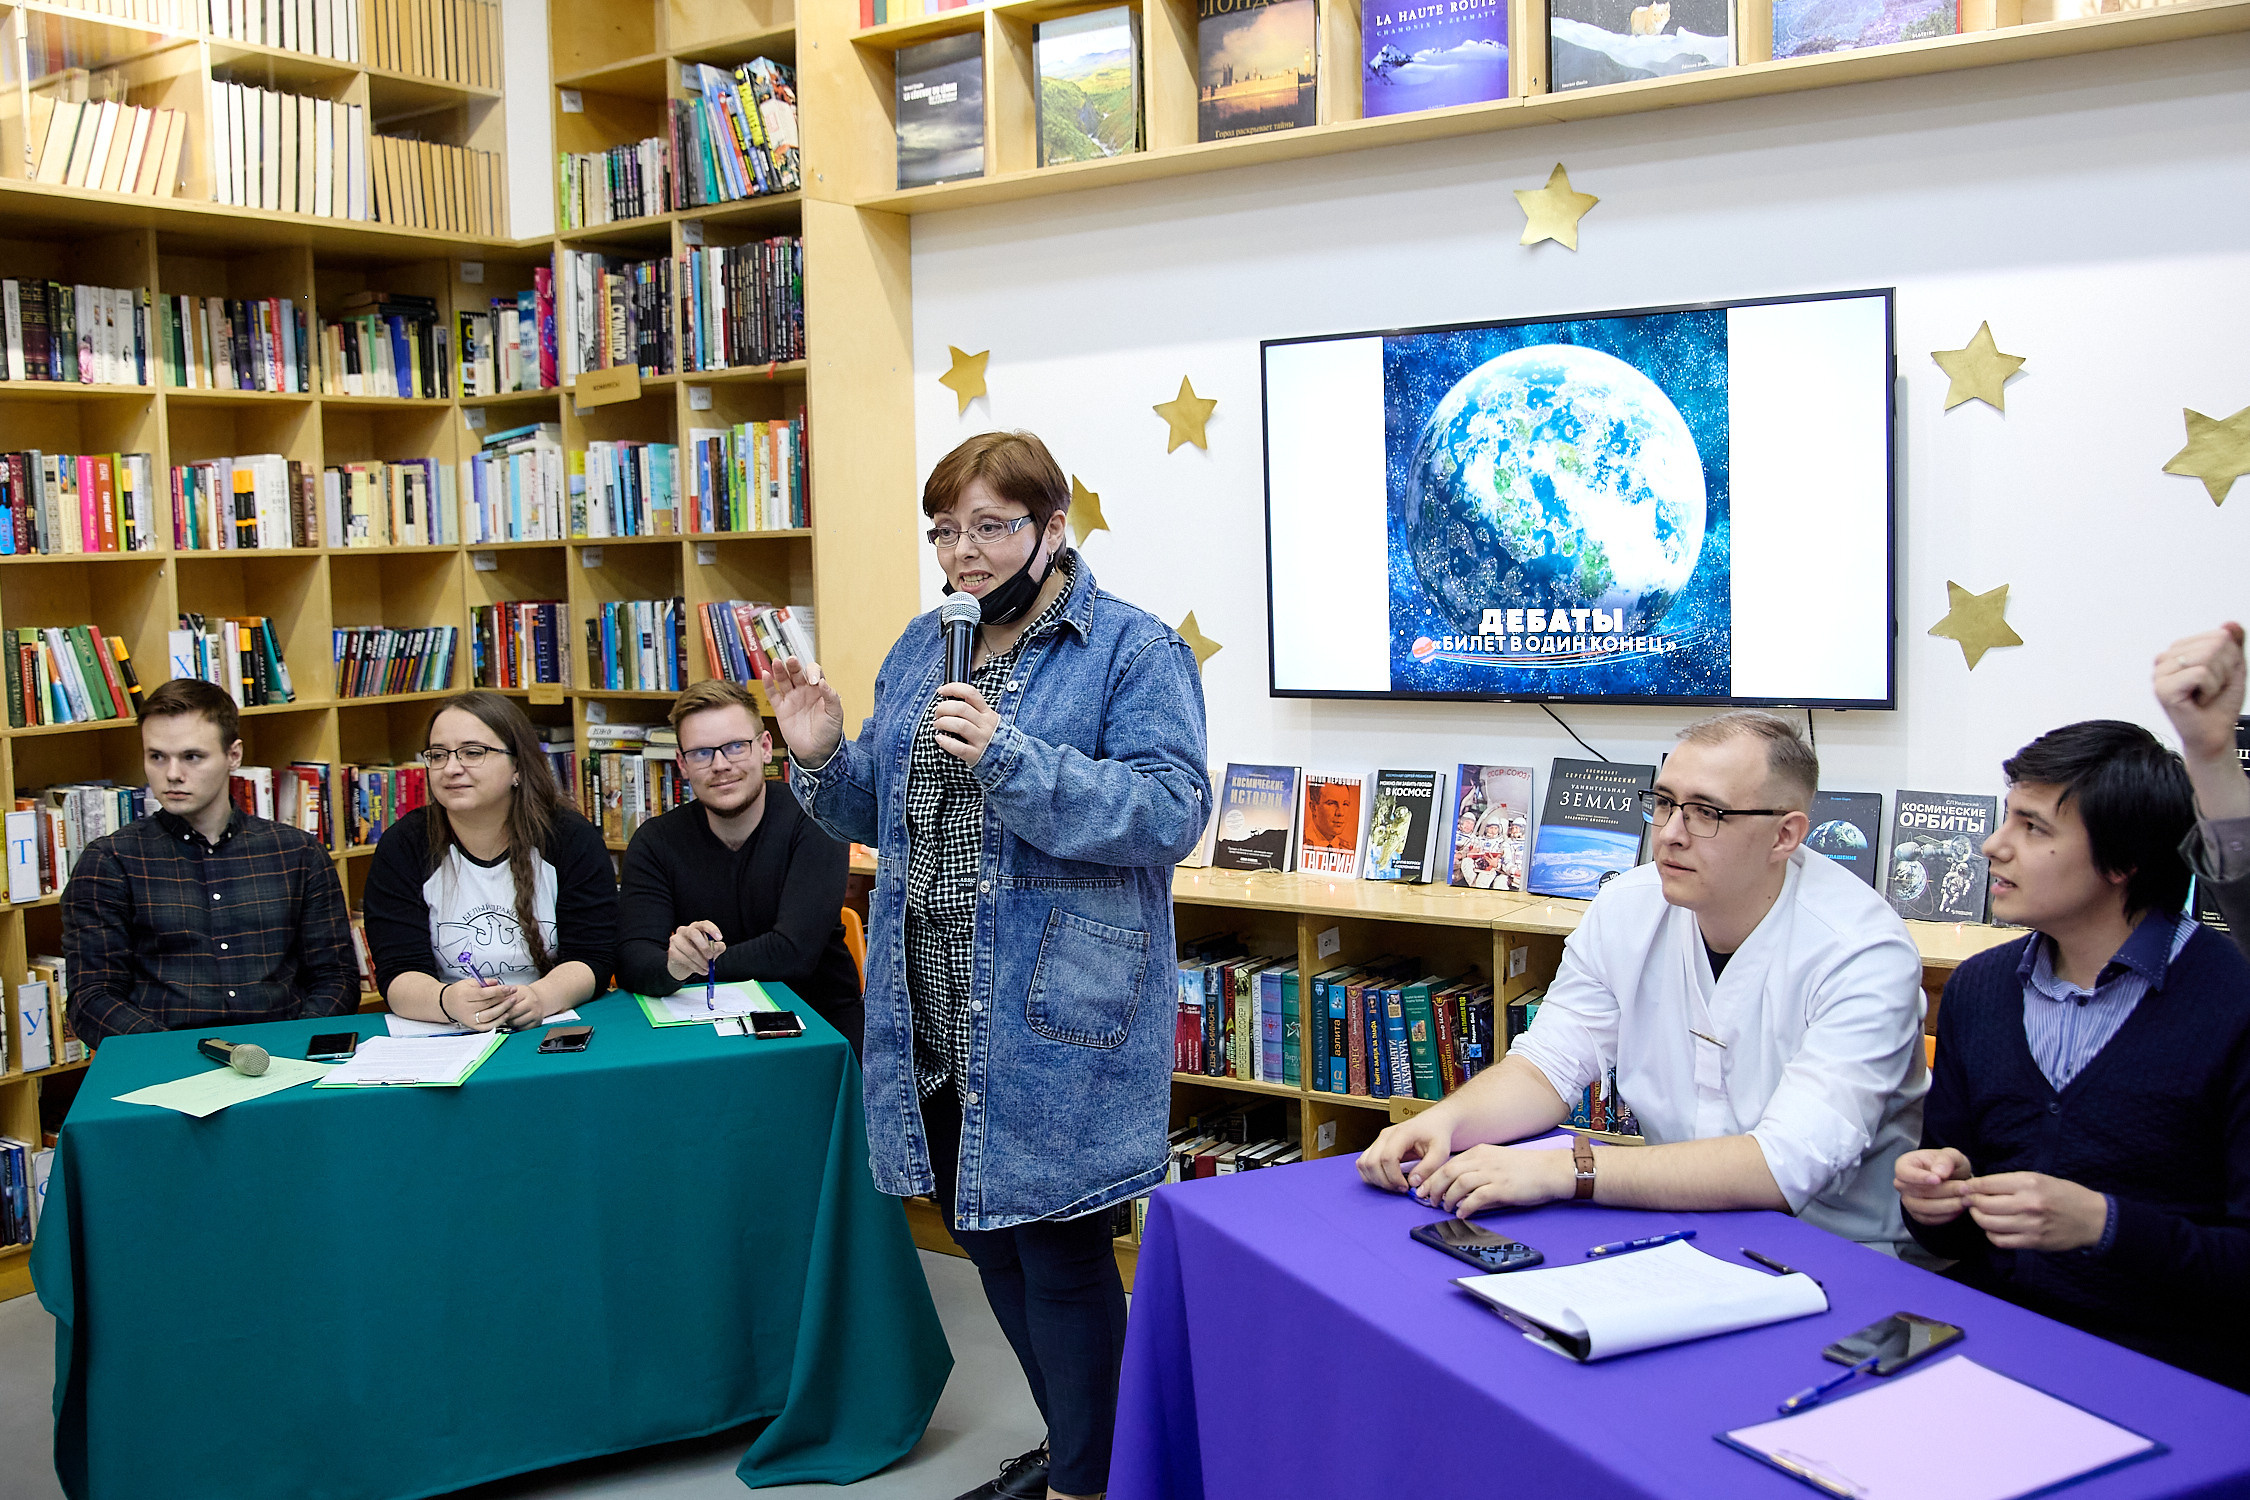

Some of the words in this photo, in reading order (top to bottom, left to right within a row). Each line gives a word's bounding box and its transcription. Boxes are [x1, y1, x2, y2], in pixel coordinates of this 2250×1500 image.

[1376, 15, 1392, 27] LA
[1398, 4, 1444, 22] HAUTE
[1376, 22, 1431, 37] CHAMONIX
[1449, 10, 1497, 24] ZERMATT
[1215, 129, 1236, 140] Город
[1236, 124, 1273, 137] раскрывает
[1273, 120, 1294, 132] тайны
[611, 303, 628, 361] СКУЛЬПТОР
[1479, 608, 1624, 636] ДЕБАТЫ
[743, 625, 759, 652] Свечка
[1431, 635, 1507, 653] «БИЛЕТ
[1511, 637, 1524, 652] В
[1526, 636, 1587, 654] ОДИН
[1590, 636, 1678, 655] КОНЕЦ»
[1231, 777, 1285, 792] КОСМИЧЕСКИЕ
[1487, 769, 1504, 778] СССР
[1506, 769, 1527, 779] СОЮЗ
[1565, 772, 1591, 780] СЕРГЕЙ
[1595, 775, 1637, 784] РЯЗАНСКИЙ
[1230, 789, 1284, 808] ИСТОРИИ
[1385, 788, 1391, 796] В
[1392, 788, 1432, 798] КОСМОСЕ
[1571, 784, 1627, 794] УДИВИТЕЛЬНАЯ
[1559, 791, 1633, 812] ЗЕМЛЯ
[1901, 802, 1987, 818] КОСМИЧЕСКИЕ
[1899, 812, 1986, 833] ОРБИТЫ
[12, 838, 33, 865] Т
[1302, 849, 1355, 874] ГАГАРИН
[462, 903, 491, 922] БЕЛЫЙ
[490, 904, 518, 919] ДРАКО
[1252, 977, 1260, 1016] ДЖОРДЖ
[22, 1007, 44, 1037] У
[1333, 1019, 1341, 1057] аэлита
[1239, 1043, 1247, 1069] РОБЕРТ
[1352, 1045, 1360, 1071] АРЕС
[1389, 1039, 1403, 1093] АНДРОНАТИ
[1399, 1039, 1412, 1093] ЛАЗАРЧУК
